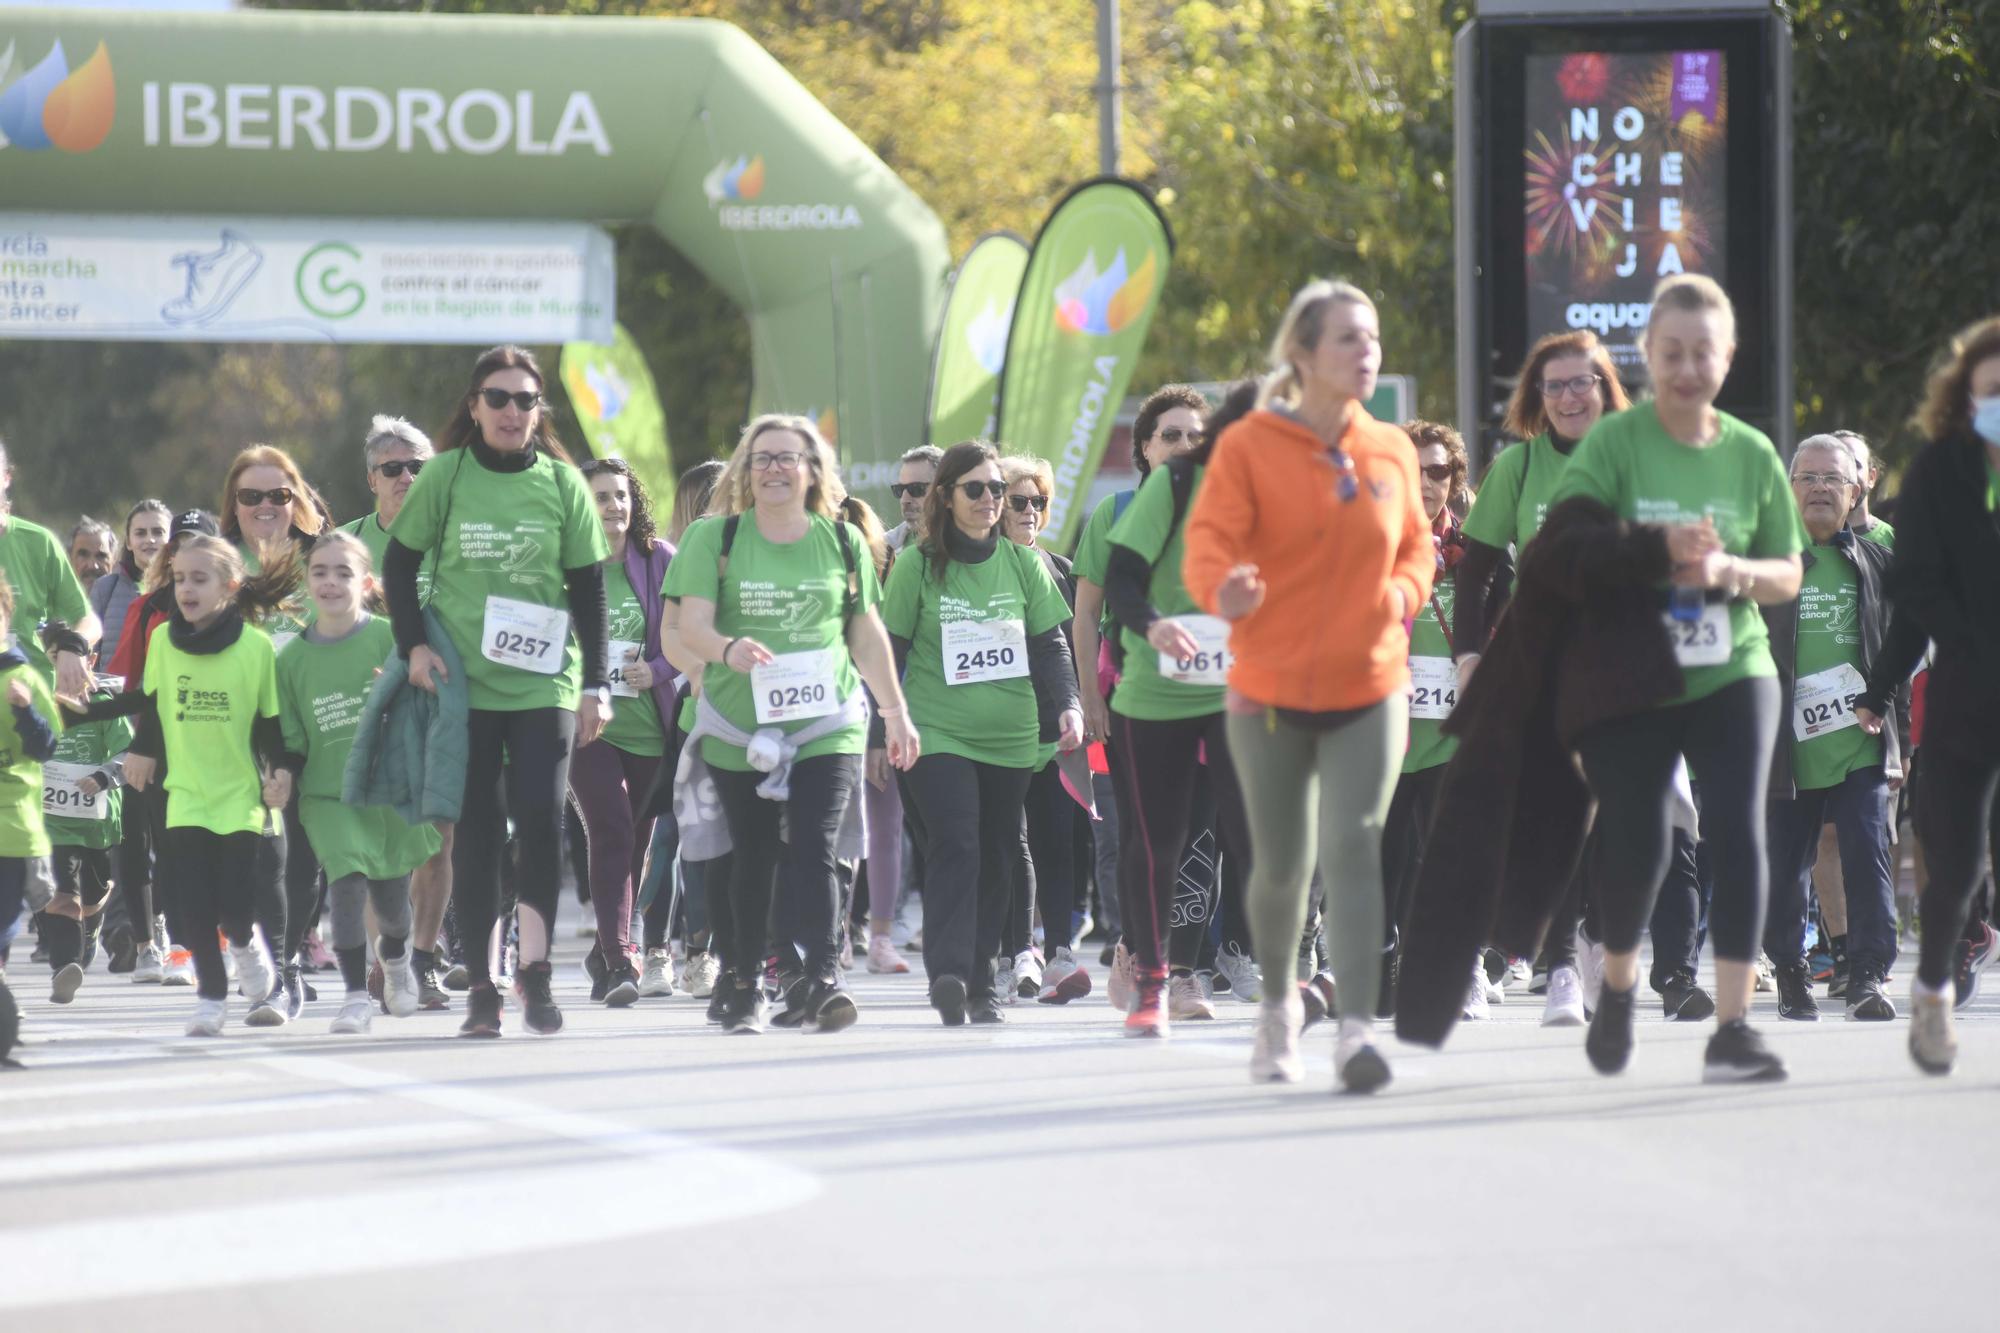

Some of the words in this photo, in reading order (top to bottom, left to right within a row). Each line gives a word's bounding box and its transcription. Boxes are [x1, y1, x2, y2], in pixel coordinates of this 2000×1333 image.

[143, 82, 612, 156] IBERDROLA
[719, 204, 864, 231] IBERDROLA
[0, 233, 48, 257] rcia
[1042, 355, 1120, 541] IBERDROLA
[460, 523, 493, 532] Murcia
[473, 531, 512, 541] marcha
[460, 541, 492, 549] contra
[462, 549, 470, 558] el
[471, 548, 505, 558] cáncer
[740, 581, 775, 590] Murcia
[1800, 585, 1819, 594] rcia
[740, 591, 752, 599] en
[754, 590, 793, 599] marcha
[940, 595, 970, 607] Murcia
[1803, 593, 1837, 602] marcha
[740, 599, 773, 607] contra
[1800, 603, 1818, 611] ntra
[741, 608, 749, 616] el
[751, 607, 786, 616] cáncer
[953, 606, 987, 617] marcha
[1800, 611, 1831, 619] cáncer
[1671, 621, 1718, 647] 23
[495, 630, 551, 659] 0257
[956, 647, 1014, 671] 2450
[1177, 651, 1233, 672] 061
[312, 692, 343, 706] Murcia
[769, 683, 825, 708] 0260
[1407, 687, 1456, 707] 214
[313, 706, 326, 716] en
[327, 696, 362, 711] marcha
[1803, 693, 1857, 725] 0215
[316, 710, 347, 724] contra
[320, 723, 330, 732] el
[44, 786, 95, 807] 2019
